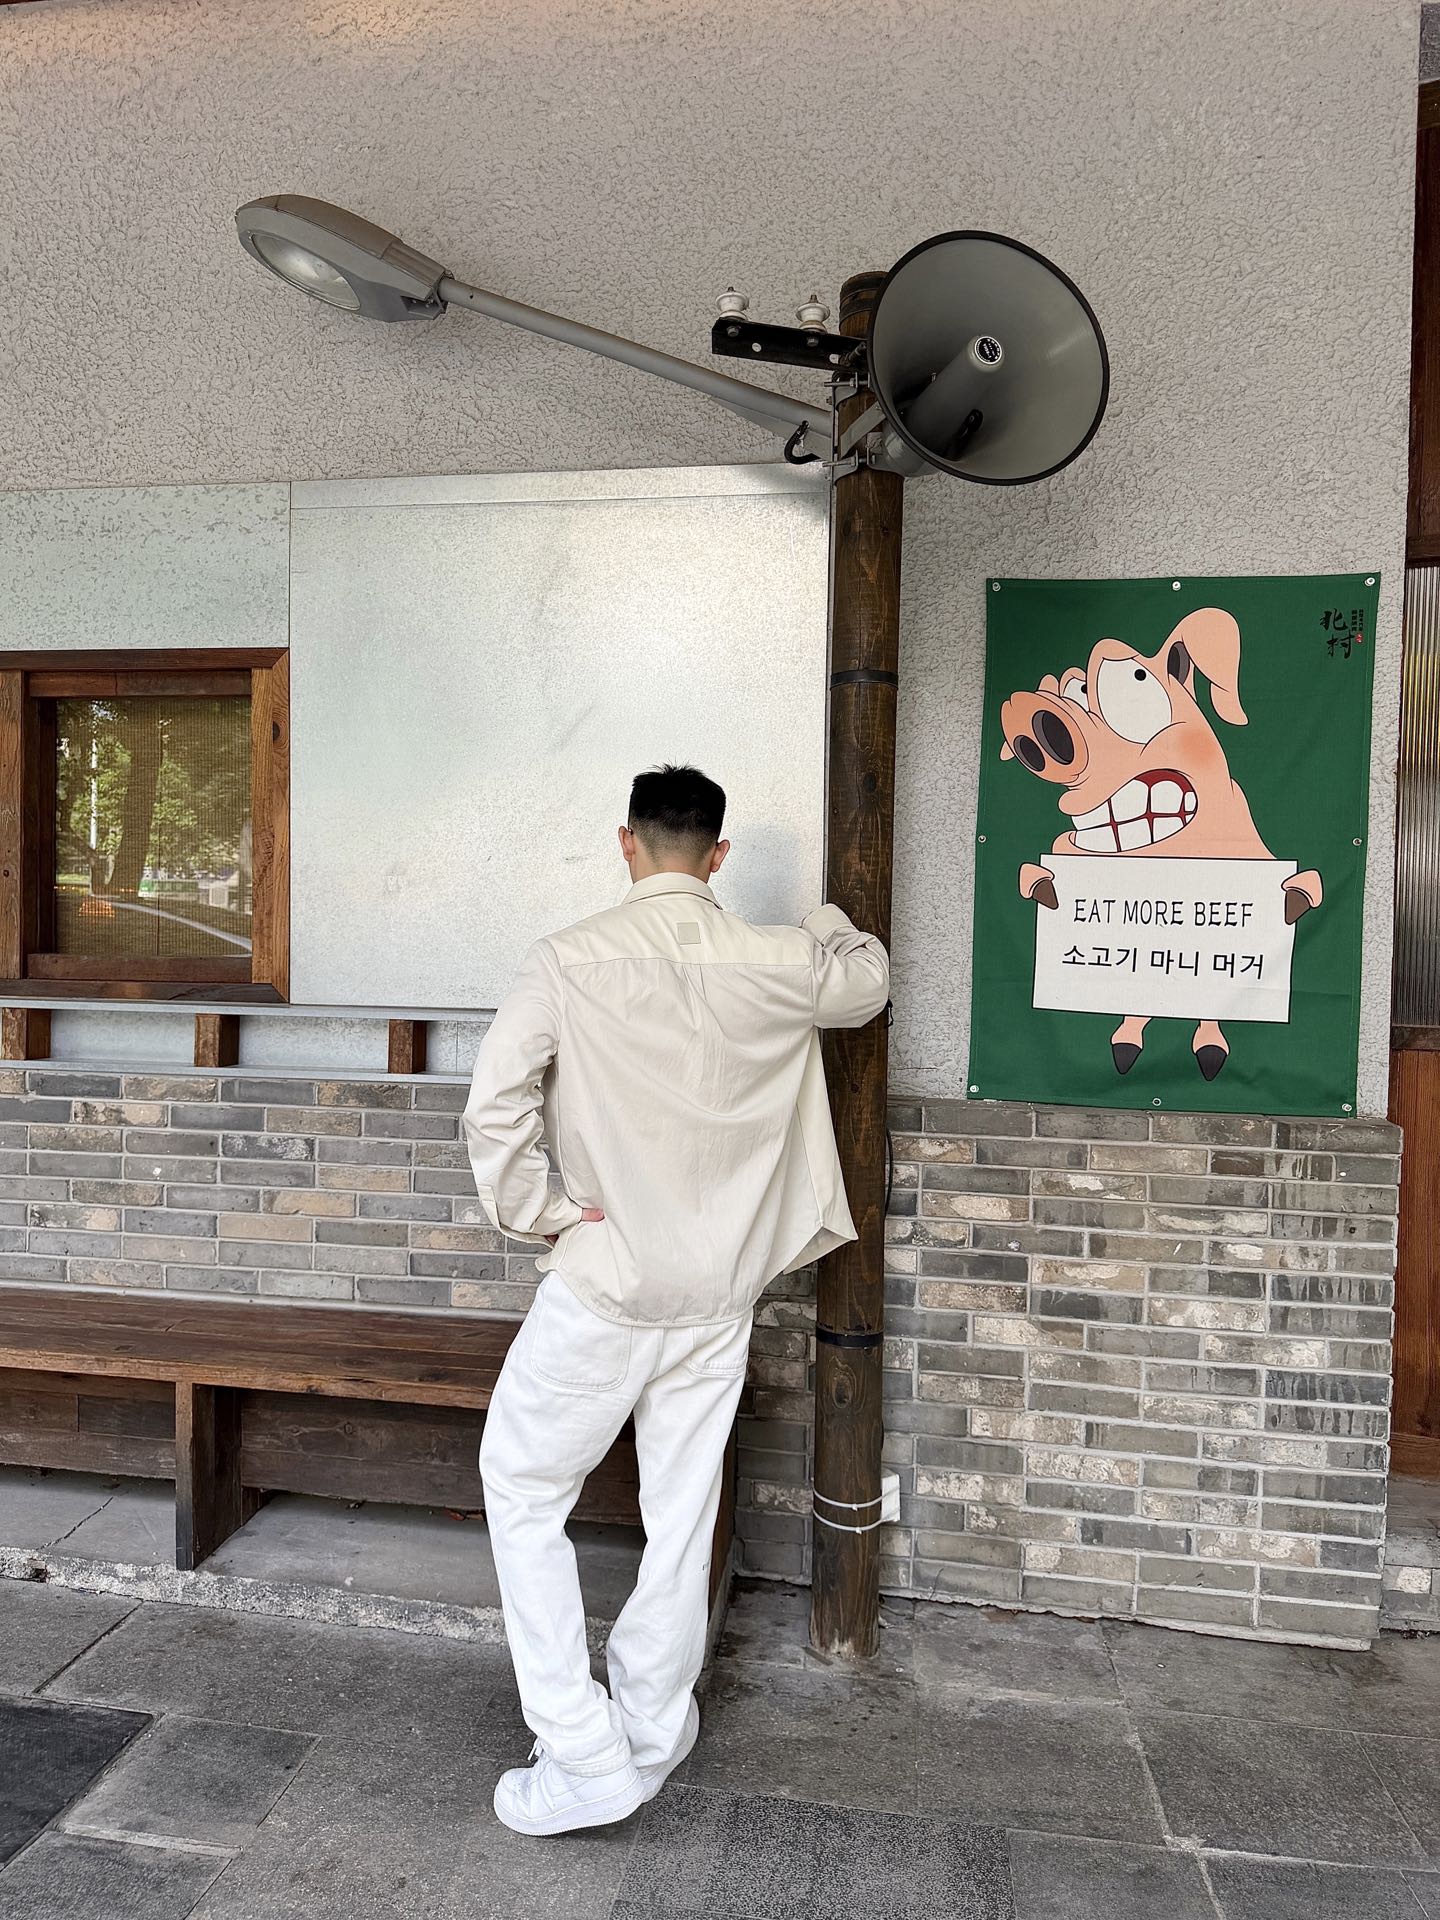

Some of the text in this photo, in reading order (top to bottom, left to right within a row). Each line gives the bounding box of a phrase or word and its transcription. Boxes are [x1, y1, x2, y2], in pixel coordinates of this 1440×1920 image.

[1319, 607, 1355, 659] 北村
[1073, 898, 1254, 927] EAT MORE BEEF
[1062, 945, 1264, 980] 소고기 마니 머거
